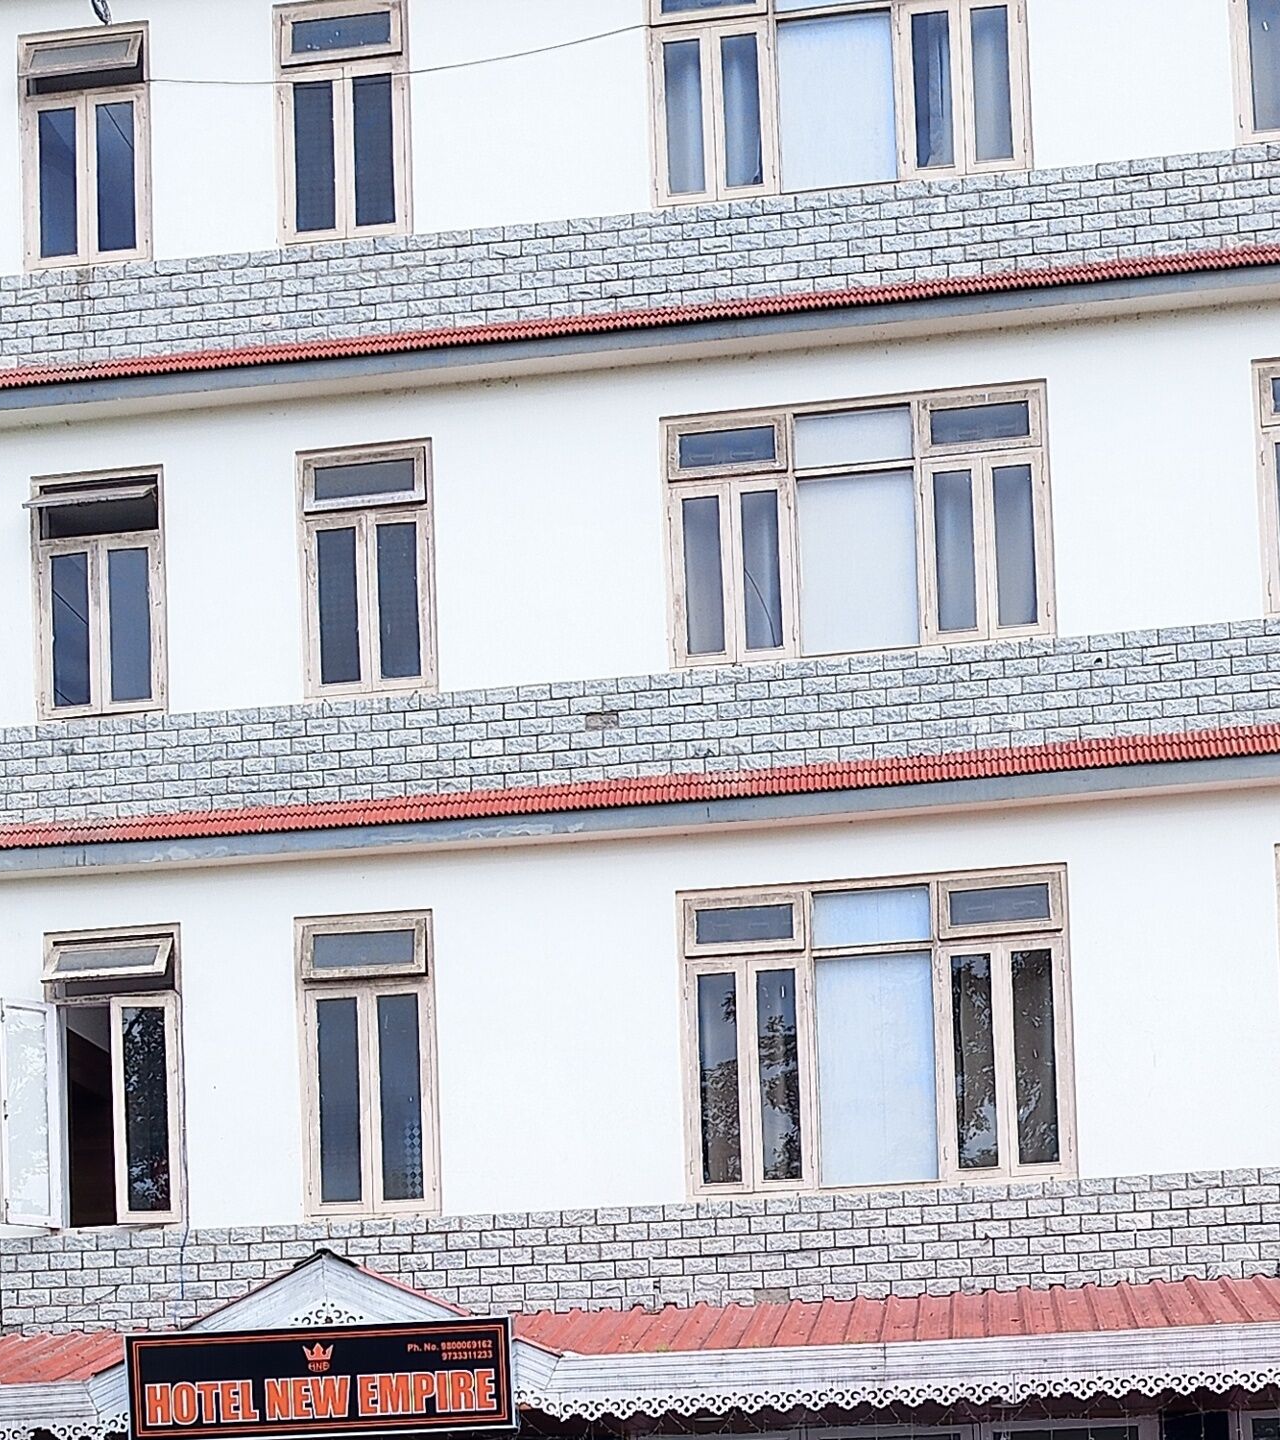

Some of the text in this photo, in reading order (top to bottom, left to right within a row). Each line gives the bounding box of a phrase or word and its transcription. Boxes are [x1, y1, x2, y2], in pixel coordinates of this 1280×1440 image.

[423, 1342, 439, 1351] No.
[144, 1368, 497, 1427] HOTEL NEW EMPIRE
